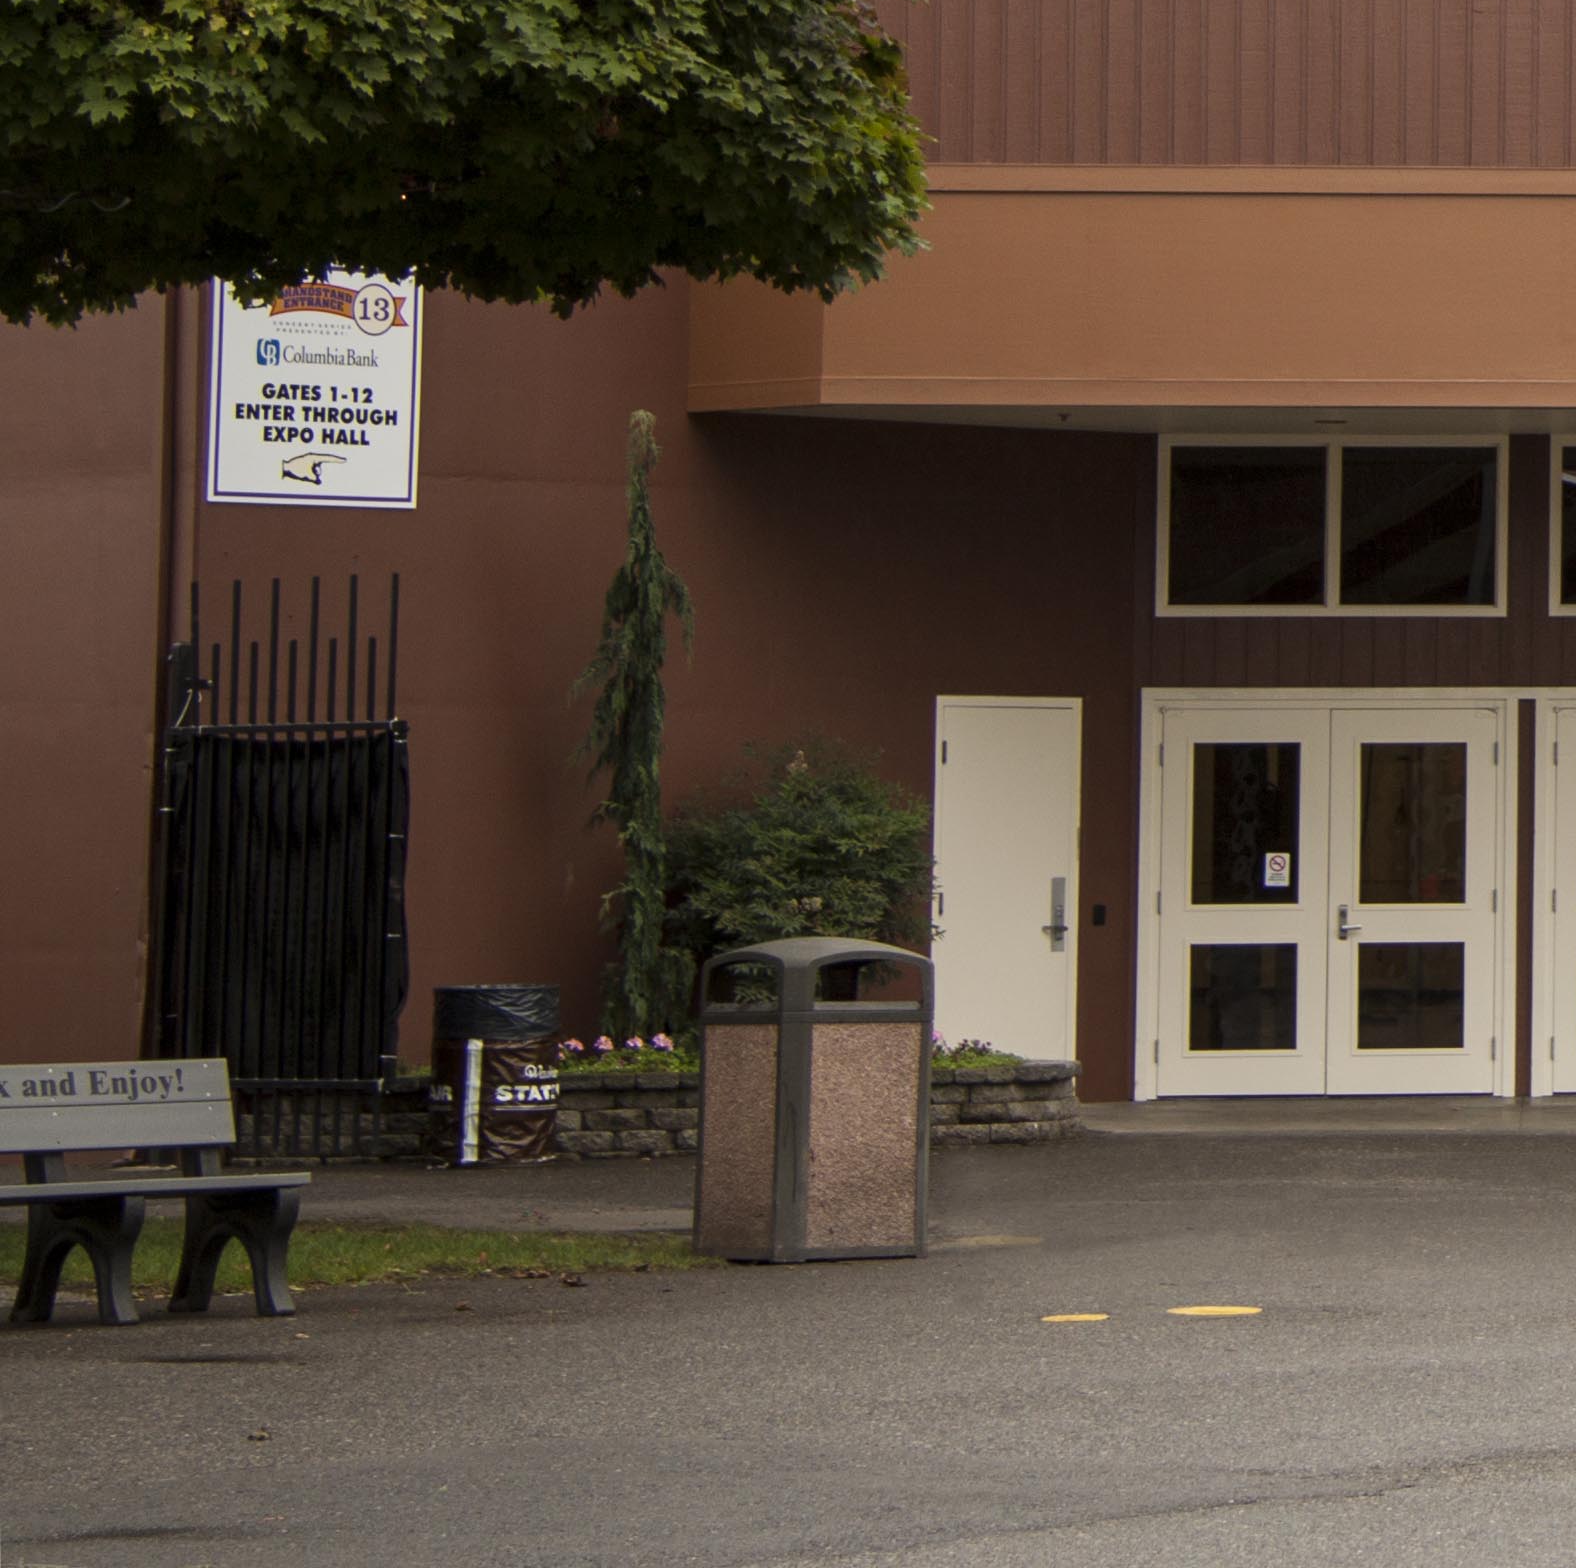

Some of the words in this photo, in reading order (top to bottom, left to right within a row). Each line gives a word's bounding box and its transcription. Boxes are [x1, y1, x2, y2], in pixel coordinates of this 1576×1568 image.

[284, 297, 344, 312] ENTRANCE
[359, 297, 390, 321] 13
[283, 345, 345, 366] Columbia
[347, 348, 379, 368] Bank
[262, 383, 321, 402] GATES
[330, 387, 373, 404] 1-12
[235, 403, 295, 422] ENTER
[302, 406, 398, 426] THROUGH
[263, 426, 314, 444] EXPO
[322, 429, 370, 446] HALL
[22, 1072, 76, 1097] and
[88, 1068, 185, 1101] Enjoy!
[495, 1083, 560, 1101] STAT
